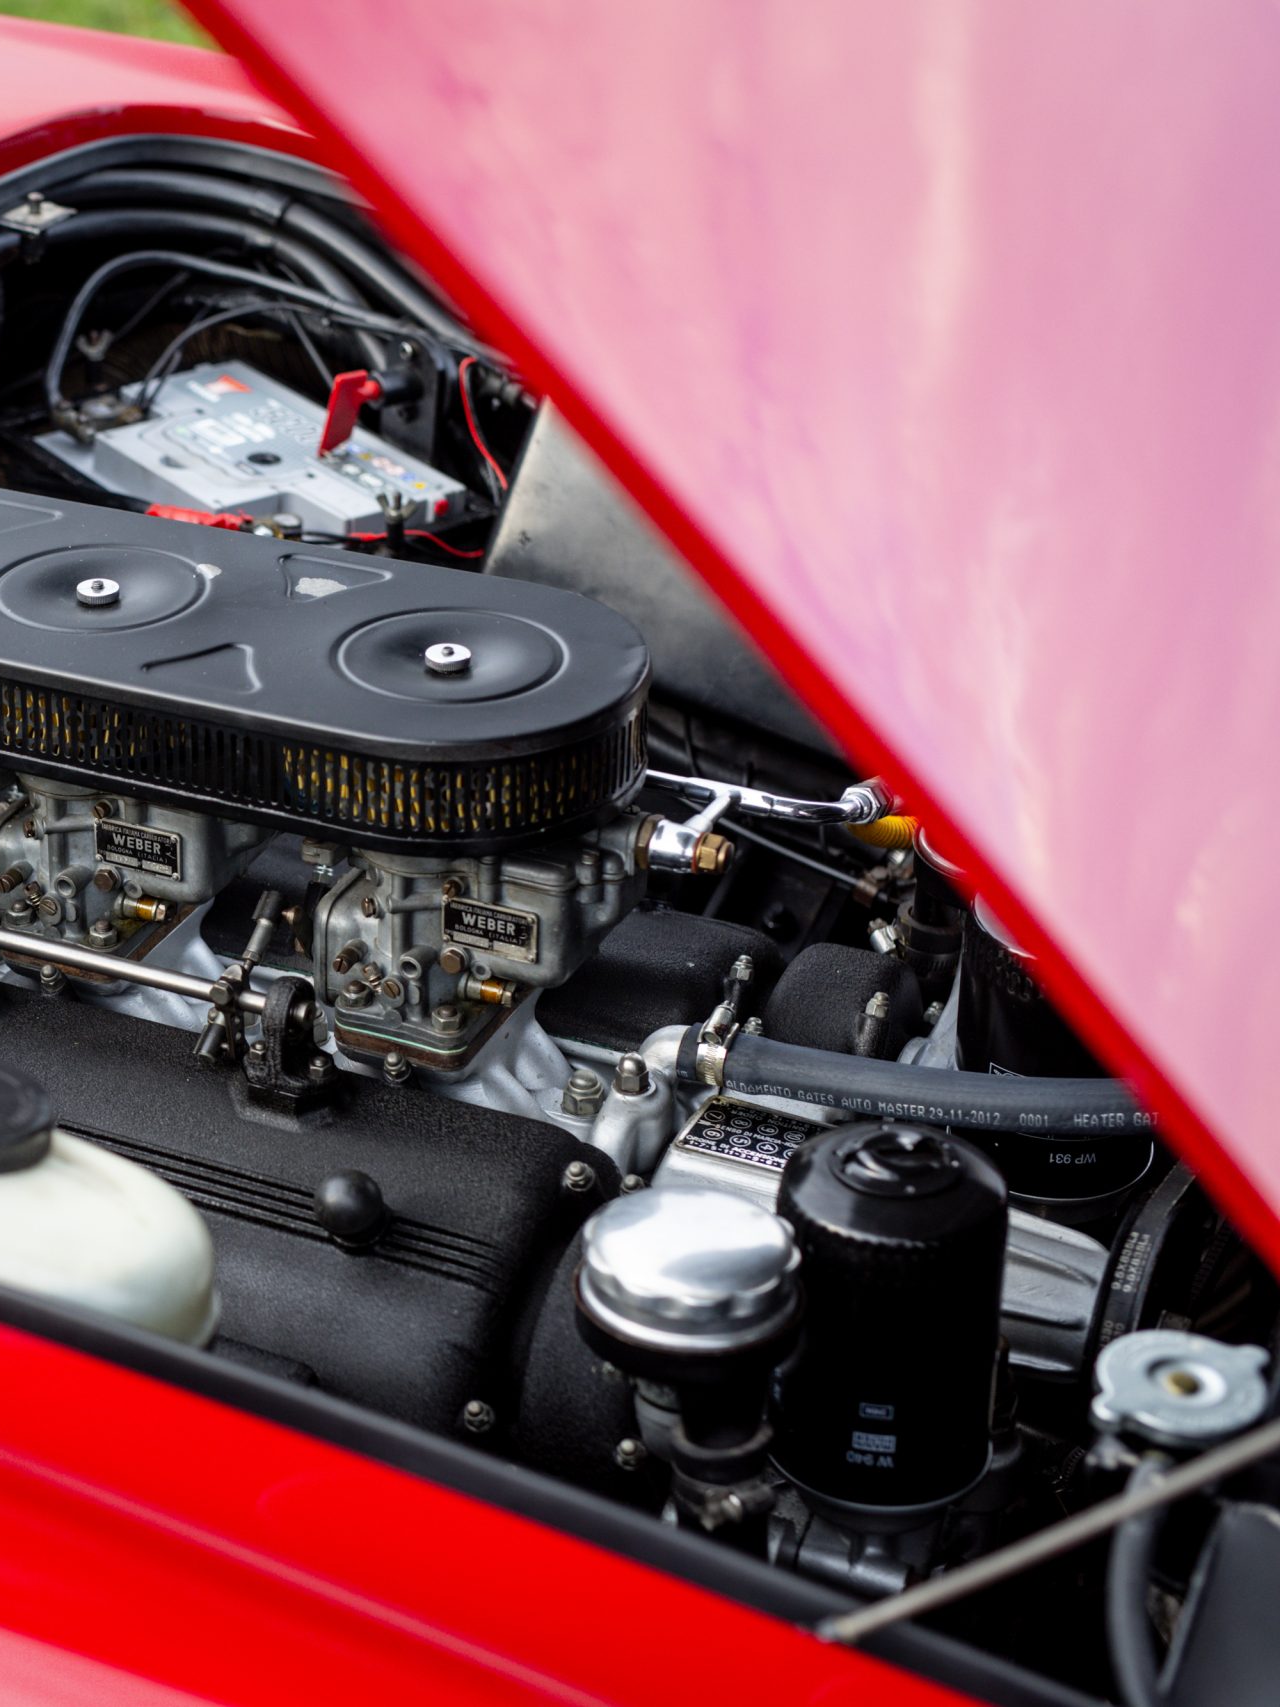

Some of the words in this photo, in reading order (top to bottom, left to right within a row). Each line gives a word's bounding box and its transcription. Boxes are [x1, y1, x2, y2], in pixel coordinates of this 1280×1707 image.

[112, 832, 161, 855] WEBER
[107, 844, 133, 855] BOLOGNA
[454, 924, 484, 935] BOLOGNA
[461, 912, 516, 936] WEBER
[797, 1090, 834, 1105] GATES
[841, 1096, 872, 1111] AUTO
[878, 1101, 925, 1118] MASTER
[929, 1106, 1001, 1125] 29-11-2012
[1019, 1113, 1049, 1127] 0001
[1074, 1113, 1125, 1128] HEATER
[1049, 1153, 1071, 1164] 931
[1075, 1153, 1097, 1164] WP
